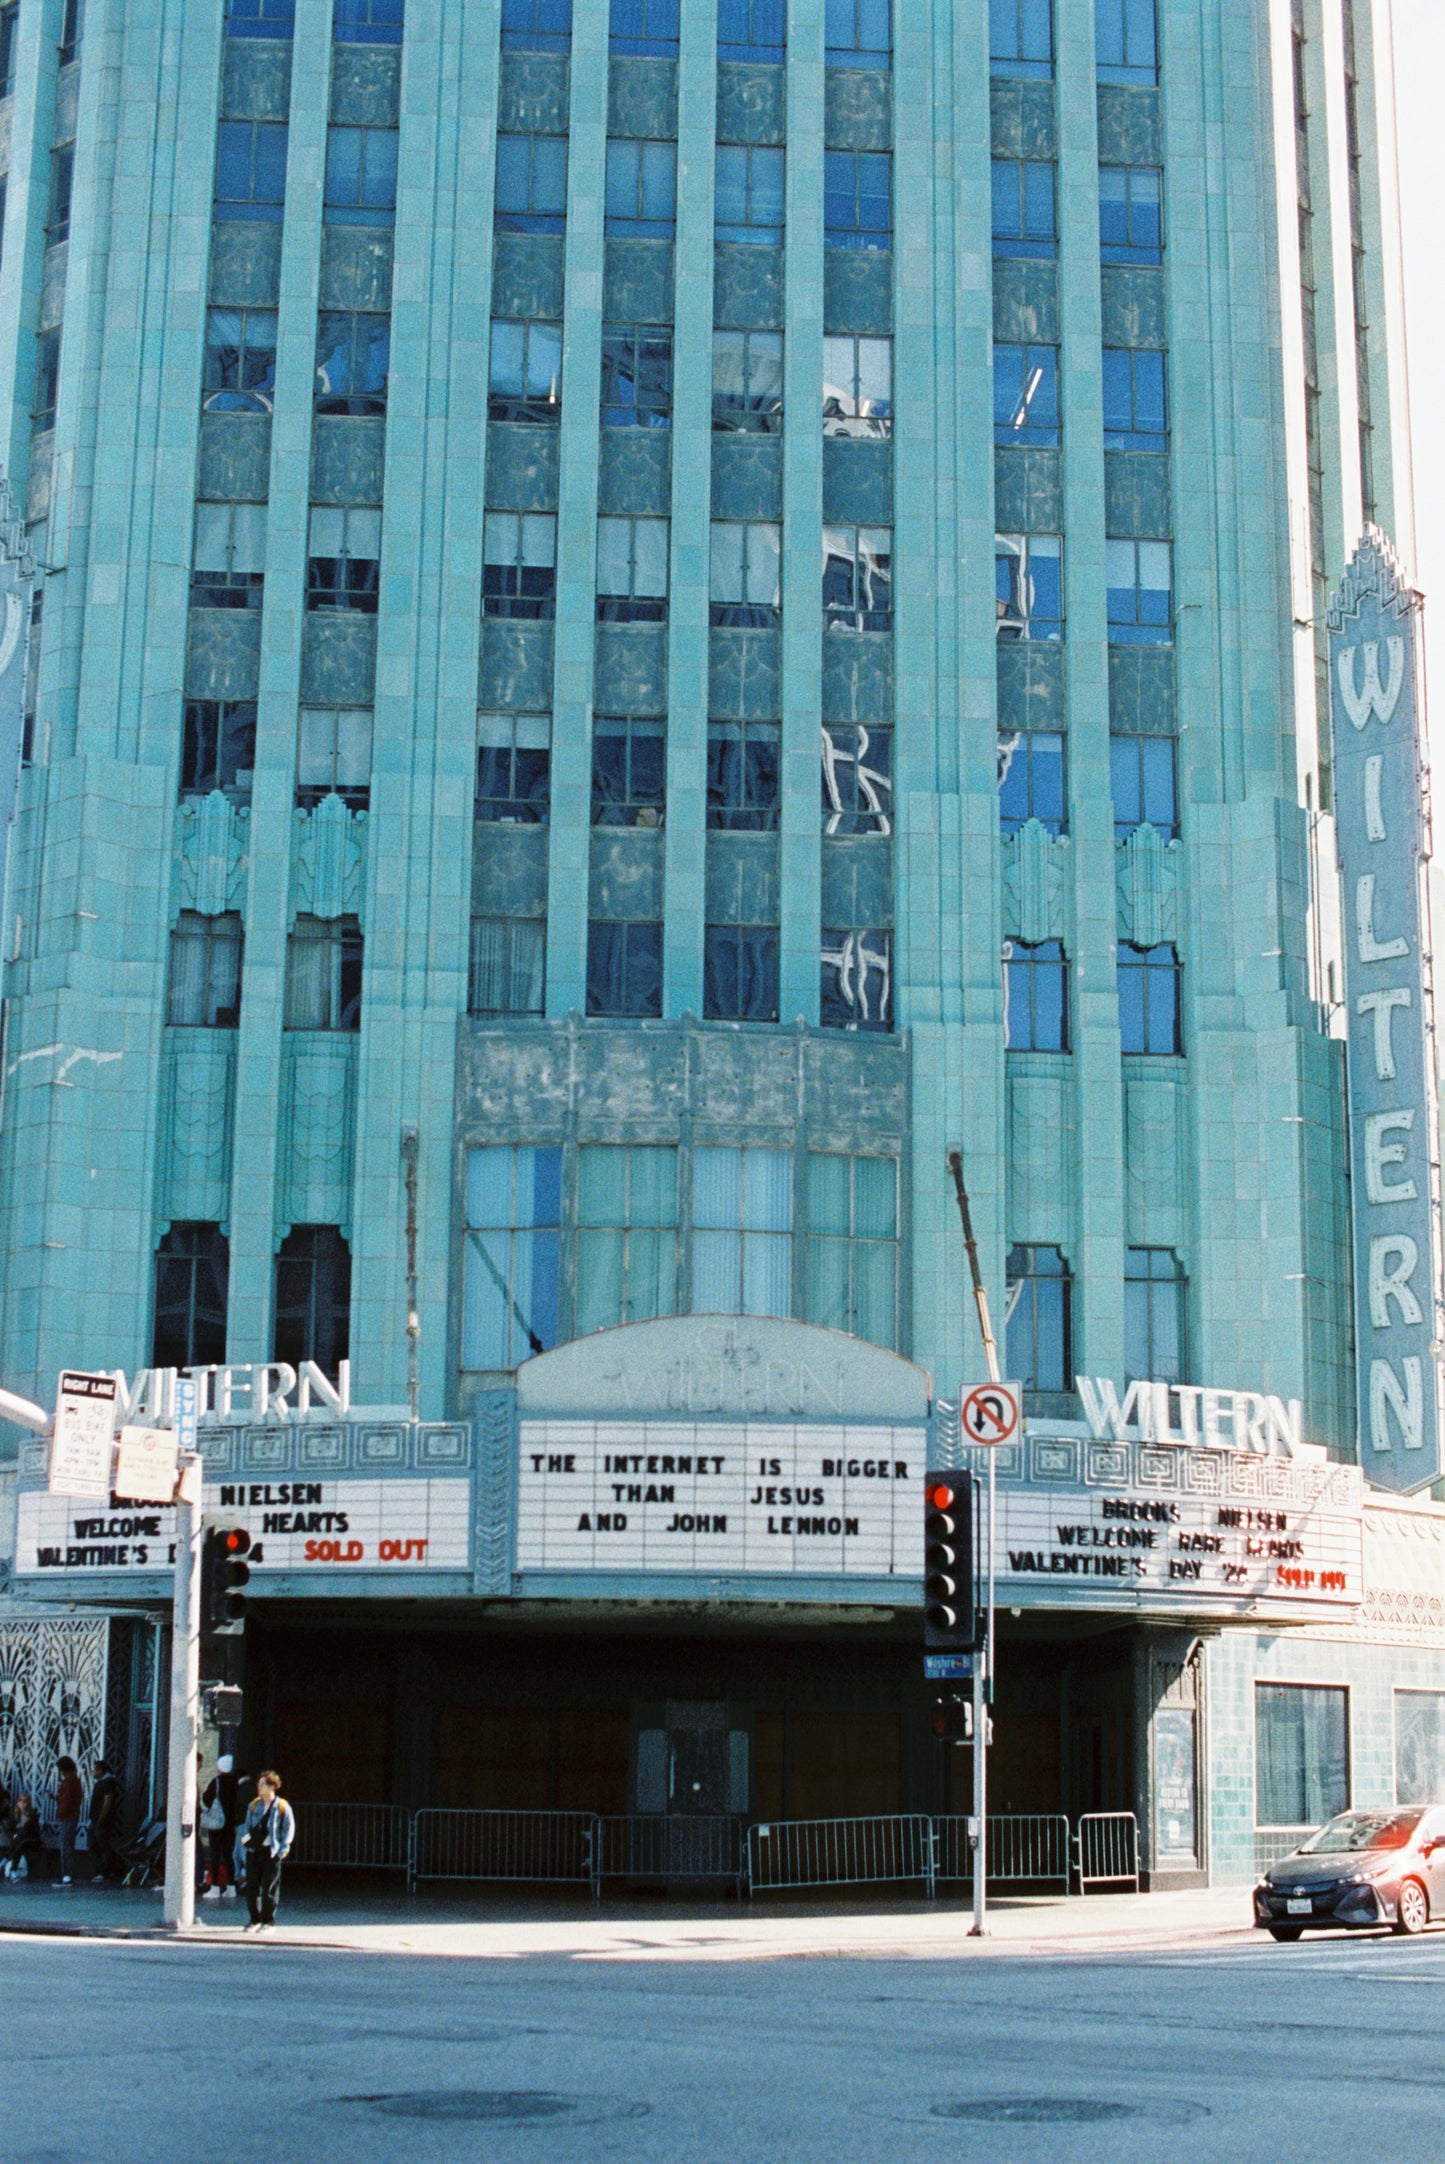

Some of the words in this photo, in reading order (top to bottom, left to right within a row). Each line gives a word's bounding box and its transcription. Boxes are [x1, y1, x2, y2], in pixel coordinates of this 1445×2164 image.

[1338, 635, 1423, 1452] WILTERN
[64, 1378, 89, 1392] RIGHT
[91, 1382, 114, 1395] LANE
[181, 1384, 195, 1445] SYNC
[1075, 1375, 1301, 1458] WILTERN
[70, 1431, 97, 1445] ONLY
[530, 1454, 576, 1474] THE
[604, 1455, 726, 1476] INTERNET
[759, 1458, 782, 1476] IS
[821, 1459, 909, 1479] BIGGER
[220, 1484, 322, 1506] NIELSEN
[611, 1484, 675, 1504] THAN
[750, 1486, 825, 1506] JESUS
[74, 1516, 161, 1539] WELCOME
[262, 1512, 349, 1534] HEARTS
[577, 1513, 628, 1533] AND
[665, 1514, 727, 1534] JOHN
[767, 1516, 860, 1536] LENNON
[1102, 1498, 1181, 1523] BROOKS
[1217, 1505, 1287, 1531] NIELSEN
[303, 1539, 364, 1562] SOLD
[378, 1538, 429, 1562] OUT
[1056, 1525, 1161, 1549] WELCOME
[1178, 1531, 1226, 1554] RARE
[37, 1544, 148, 1567] VALENTINE'S
[1008, 1550, 1147, 1577] VALENTINE'S
[1169, 1558, 1203, 1580] DAY
